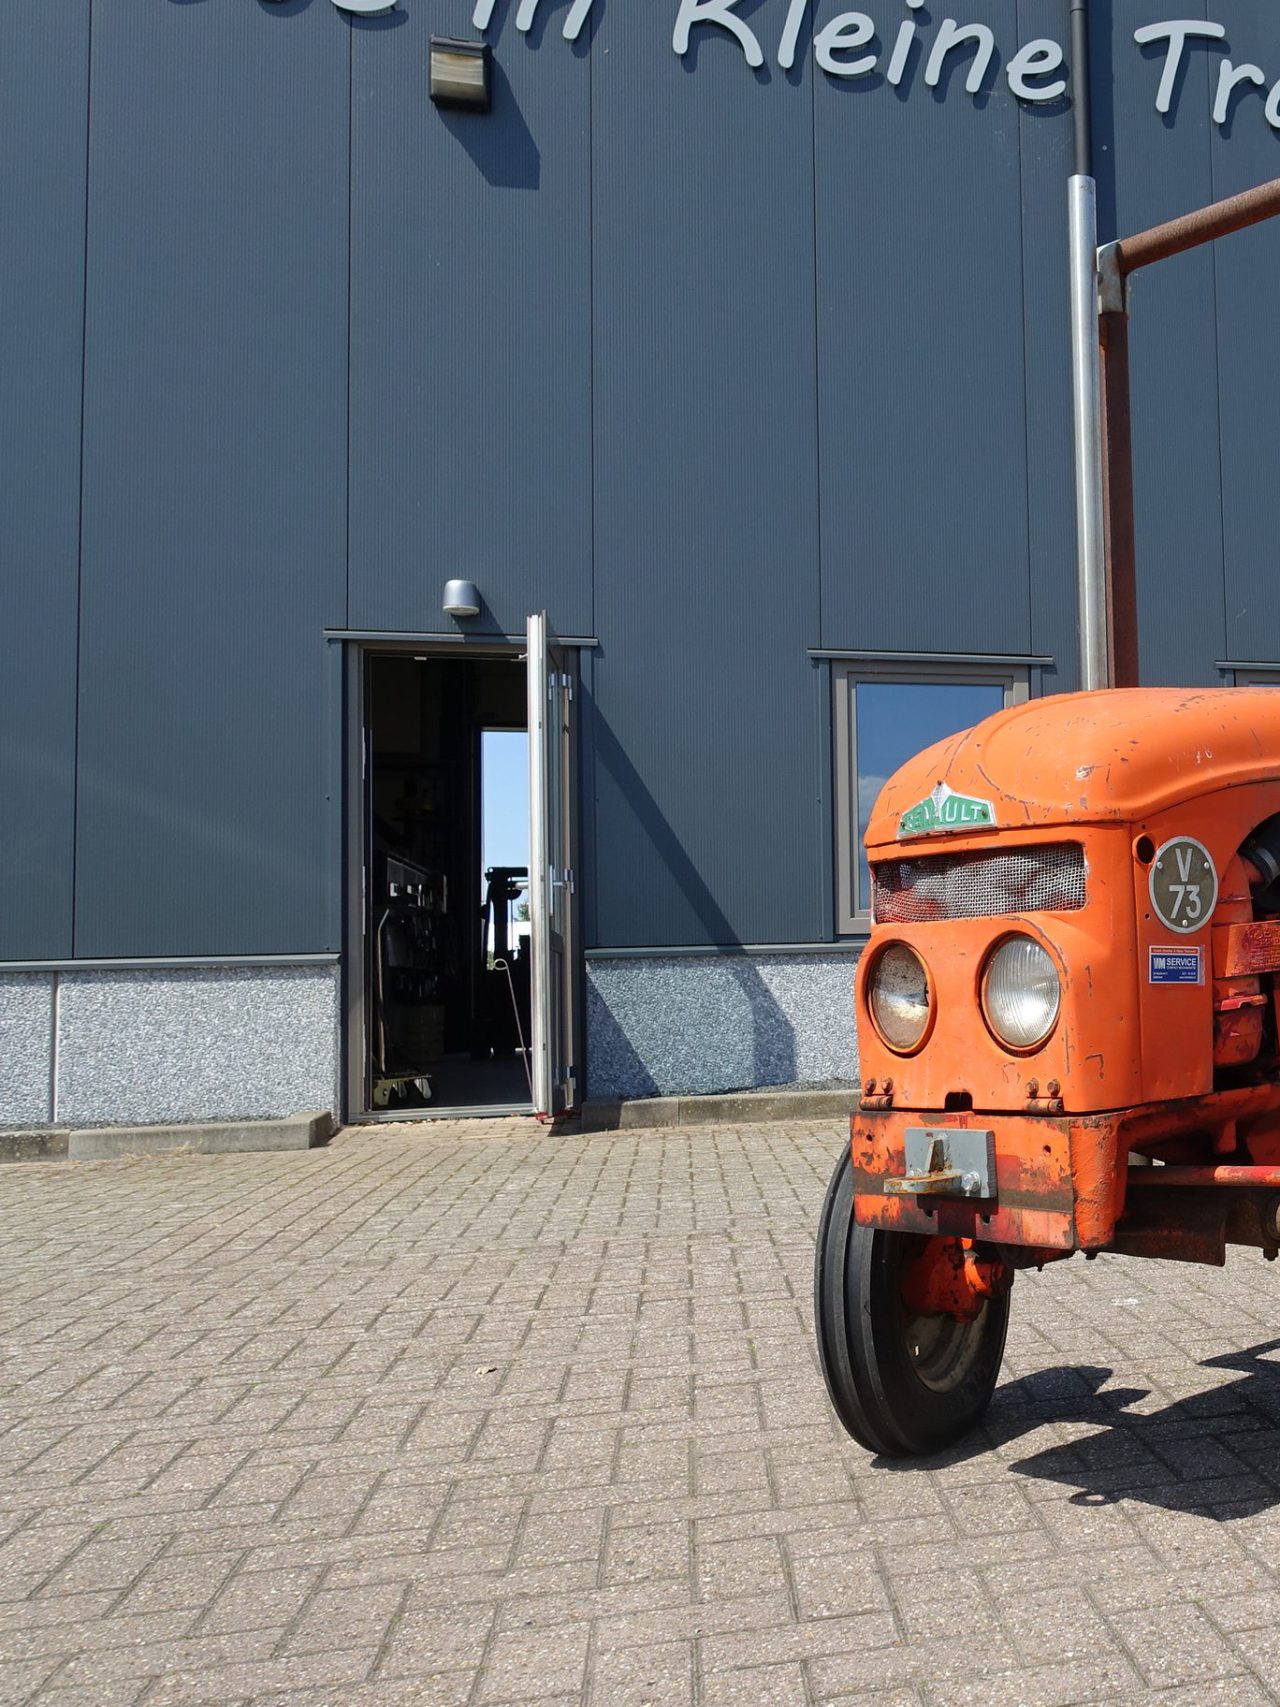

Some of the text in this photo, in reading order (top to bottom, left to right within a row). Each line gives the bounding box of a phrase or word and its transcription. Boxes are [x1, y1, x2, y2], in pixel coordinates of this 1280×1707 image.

[672, 0, 1067, 101] Kleine
[1175, 848, 1193, 882] V
[1168, 885, 1201, 919] 73
[1166, 957, 1197, 966] SERVICE
